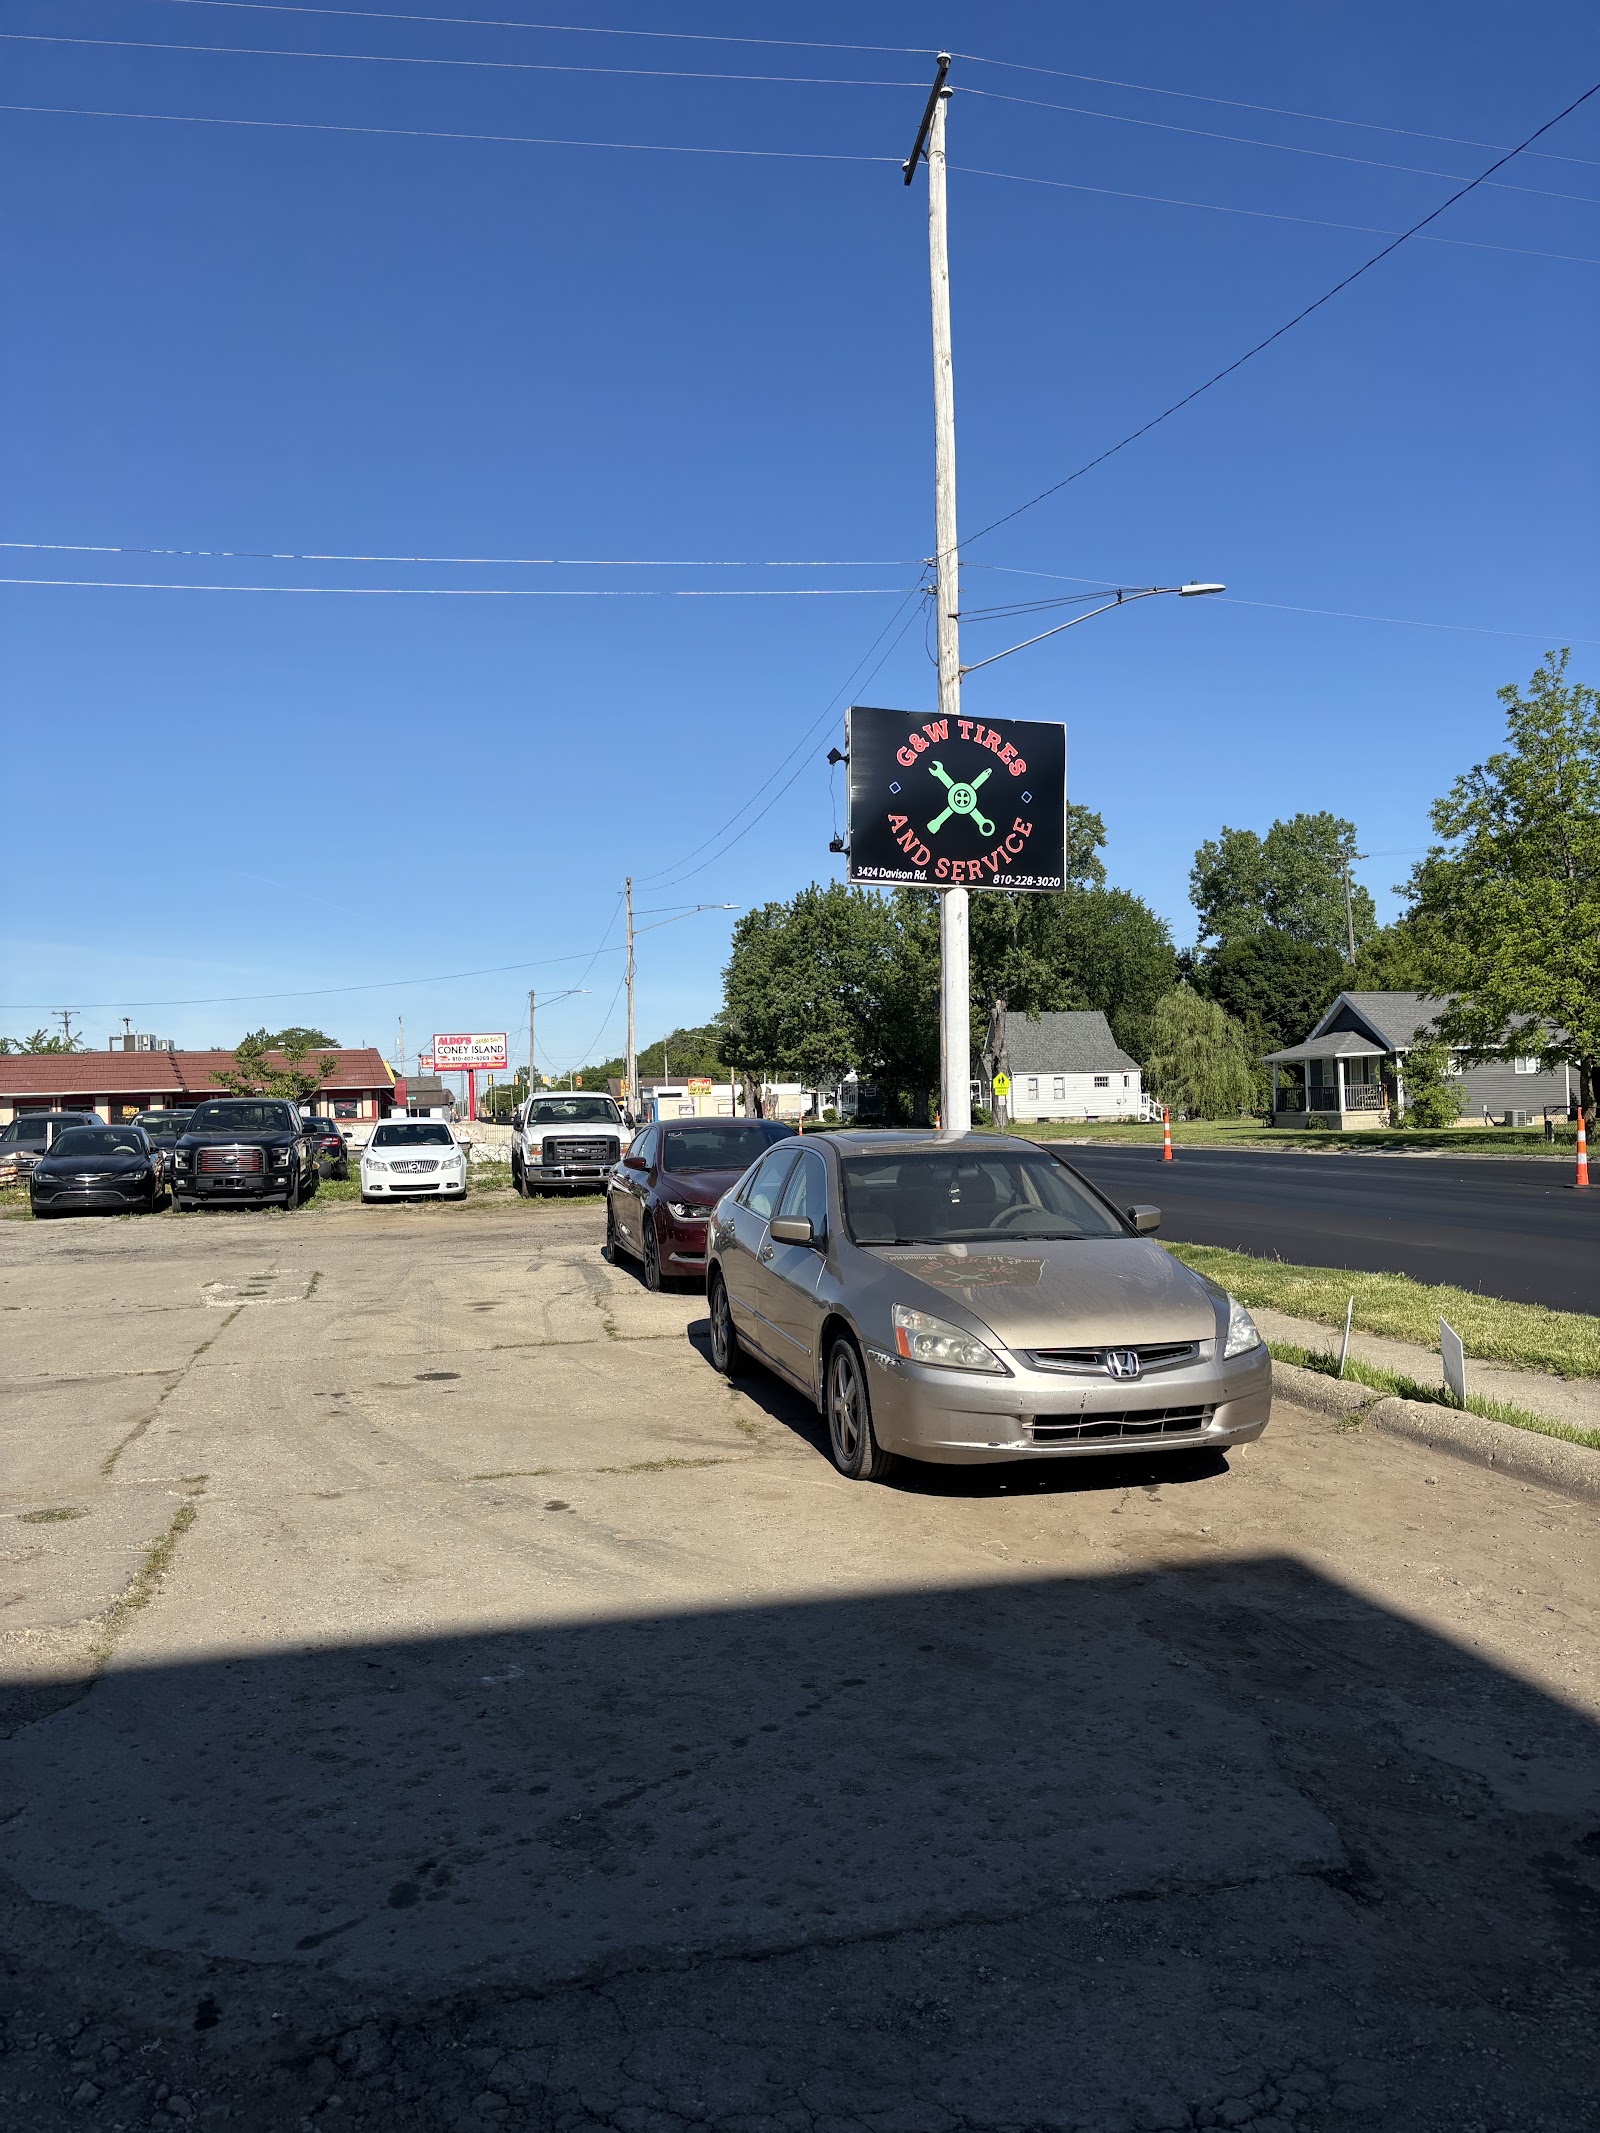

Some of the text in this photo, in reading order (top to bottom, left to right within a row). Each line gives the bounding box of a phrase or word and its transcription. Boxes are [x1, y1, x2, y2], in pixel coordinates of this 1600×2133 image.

[896, 719, 1027, 776] G&W TIRES
[888, 814, 1033, 881] AND SERVICE
[857, 866, 928, 881] 3424 Davison Rd.
[992, 874, 1061, 887] 810-228-3020
[438, 1037, 472, 1045] ALDO'S
[438, 1045, 503, 1054] CONEY ISLAND
